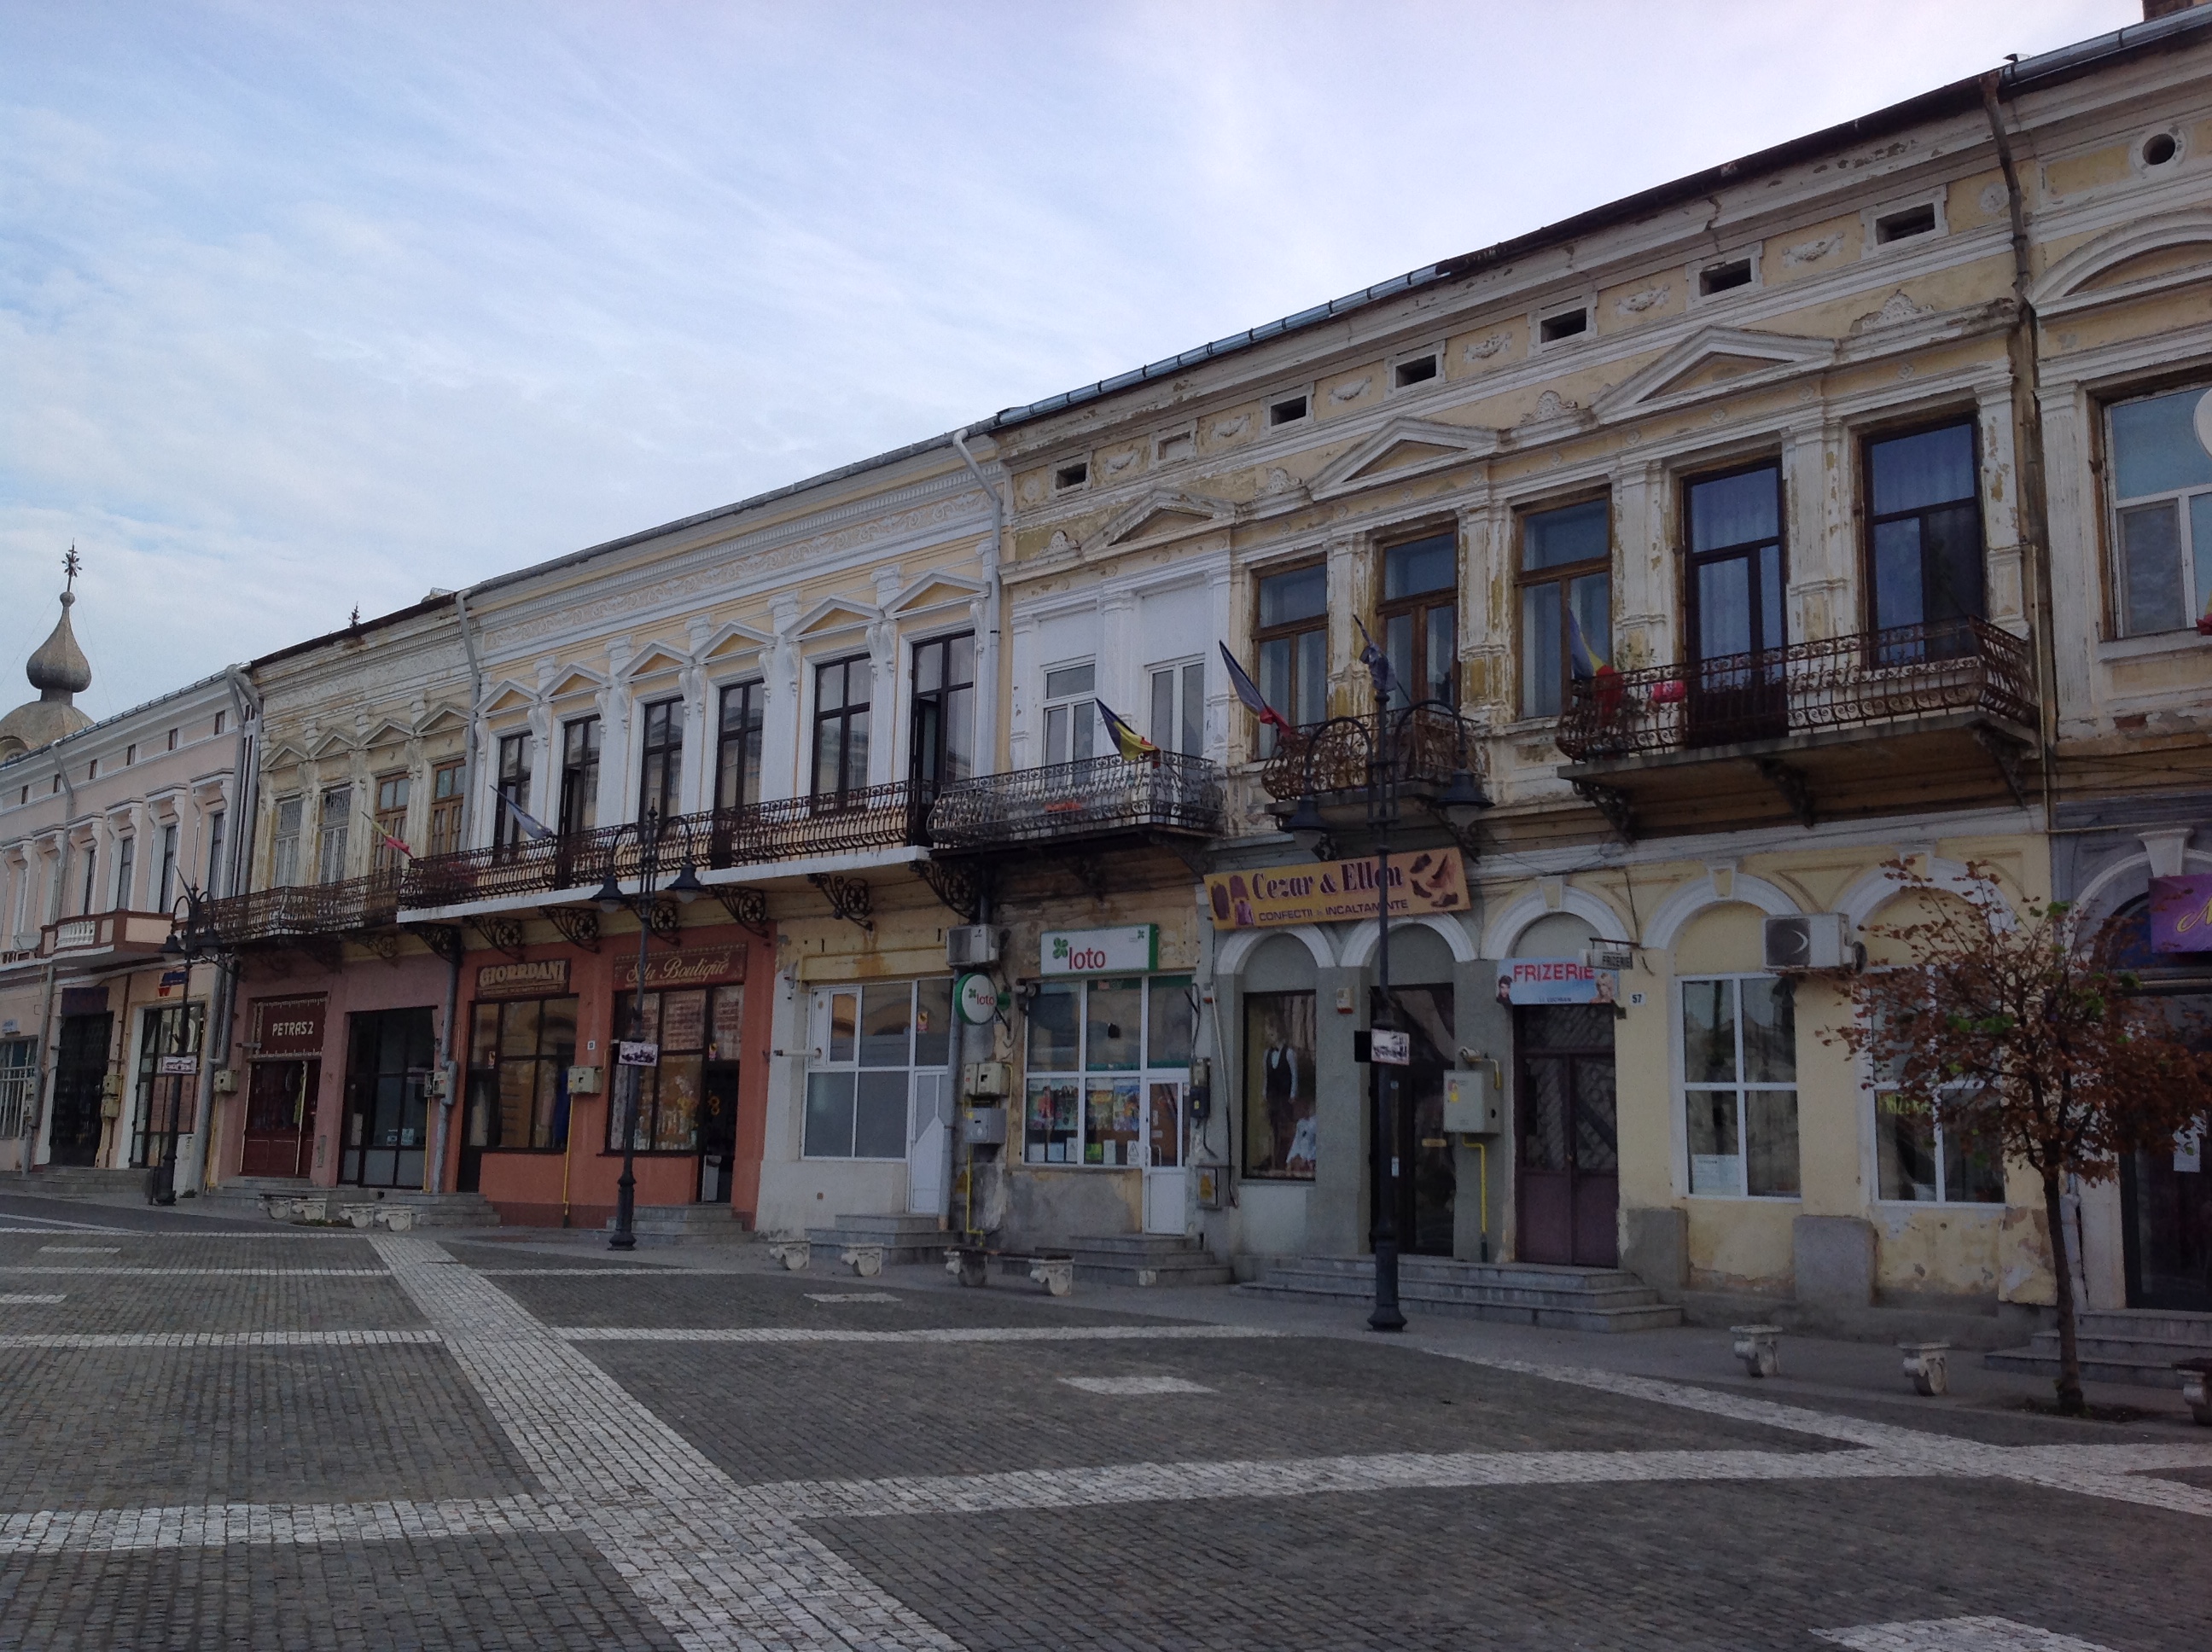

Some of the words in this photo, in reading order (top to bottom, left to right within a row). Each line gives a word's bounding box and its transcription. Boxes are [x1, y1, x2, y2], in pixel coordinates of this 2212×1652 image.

[1252, 873, 1315, 900] Cezar
[1319, 873, 1337, 893] &
[1259, 909, 1313, 922] CONFECTII
[1325, 899, 1408, 916] INCALTAMNTE
[660, 953, 731, 982] Boutique
[1068, 946, 1106, 969] loto
[1513, 963, 1596, 982] FRIZERIE
[976, 993, 995, 1005] loto
[1632, 994, 1642, 1003] 57
